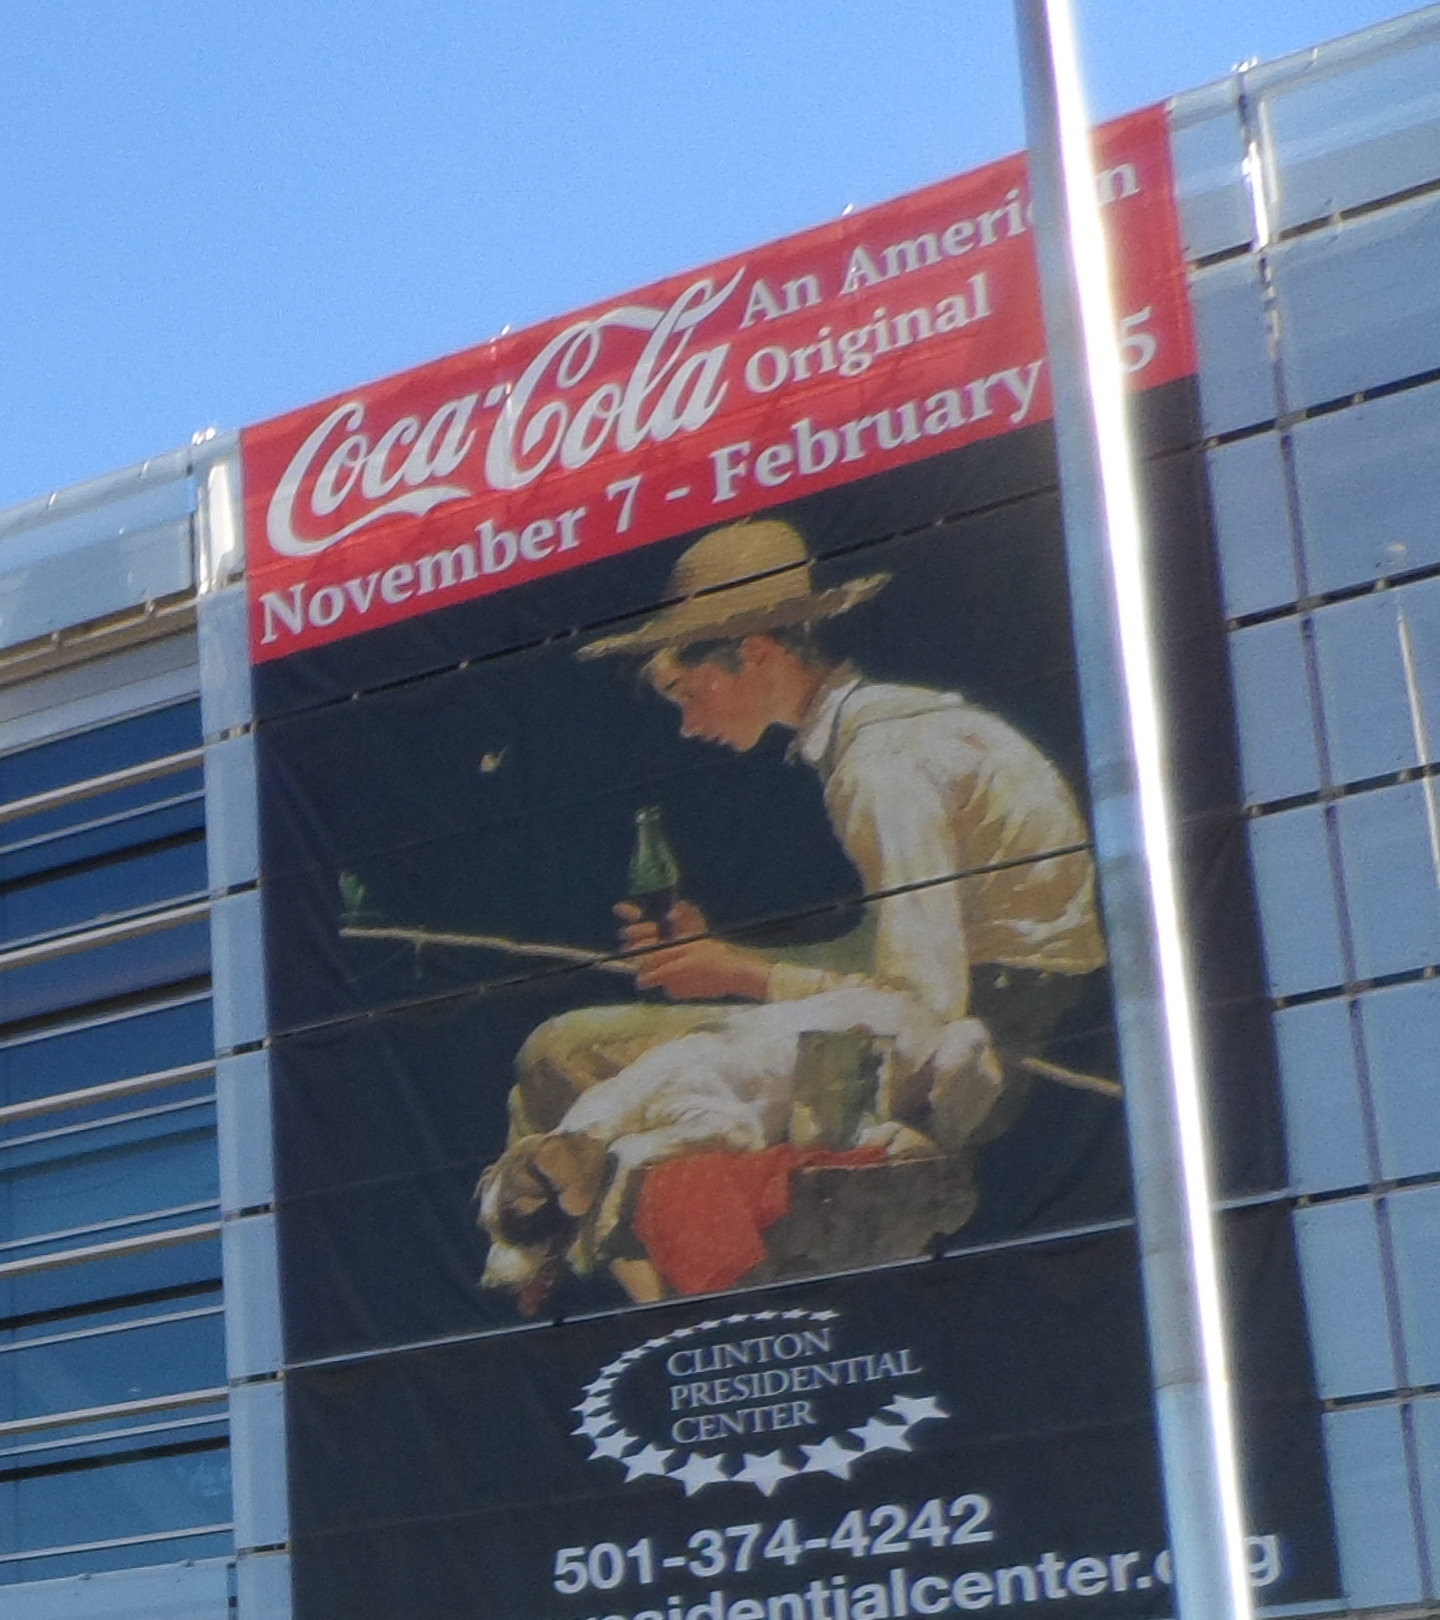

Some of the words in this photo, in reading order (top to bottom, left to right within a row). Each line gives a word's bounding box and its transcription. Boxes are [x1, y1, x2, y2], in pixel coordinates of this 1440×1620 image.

[739, 273, 821, 330] An
[839, 160, 1141, 299] Amerin
[745, 271, 992, 395] Original
[259, 506, 587, 645] November
[606, 475, 641, 533] 7
[665, 485, 691, 502] -
[711, 358, 1045, 504] February
[666, 1327, 831, 1377] CLINTON
[670, 1348, 923, 1411] PRESIDENTIAL
[671, 1400, 817, 1444] CENTER
[553, 1493, 993, 1595] 501-374-4242
